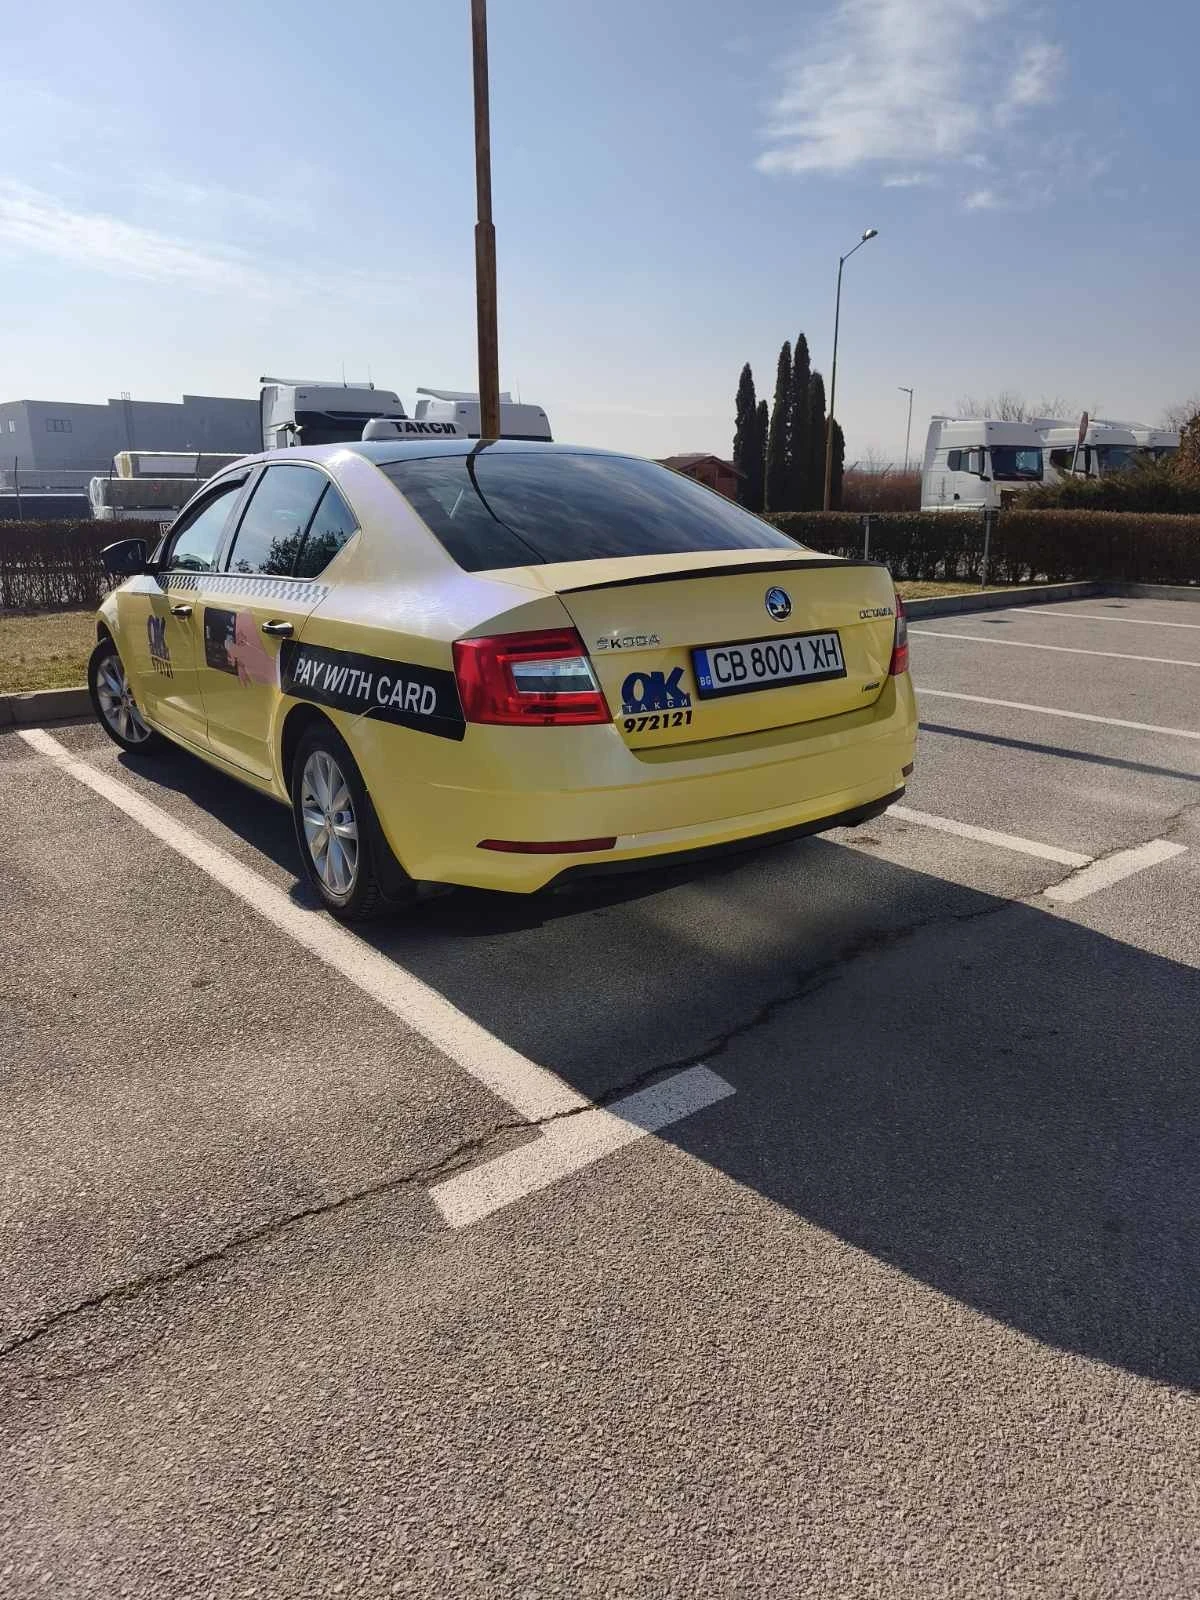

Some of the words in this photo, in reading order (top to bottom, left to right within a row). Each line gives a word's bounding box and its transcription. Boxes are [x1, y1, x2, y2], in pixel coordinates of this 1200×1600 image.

[391, 421, 457, 434] ТАКСИ
[713, 650, 747, 683] CB
[750, 641, 806, 677] 8001
[808, 637, 839, 669] XH
[293, 657, 325, 687] PAY
[323, 664, 373, 700] WITH
[376, 675, 437, 715] CARD
[700, 675, 712, 686] BG
[625, 700, 688, 713] ТАКСИ
[623, 710, 693, 734] 972121
